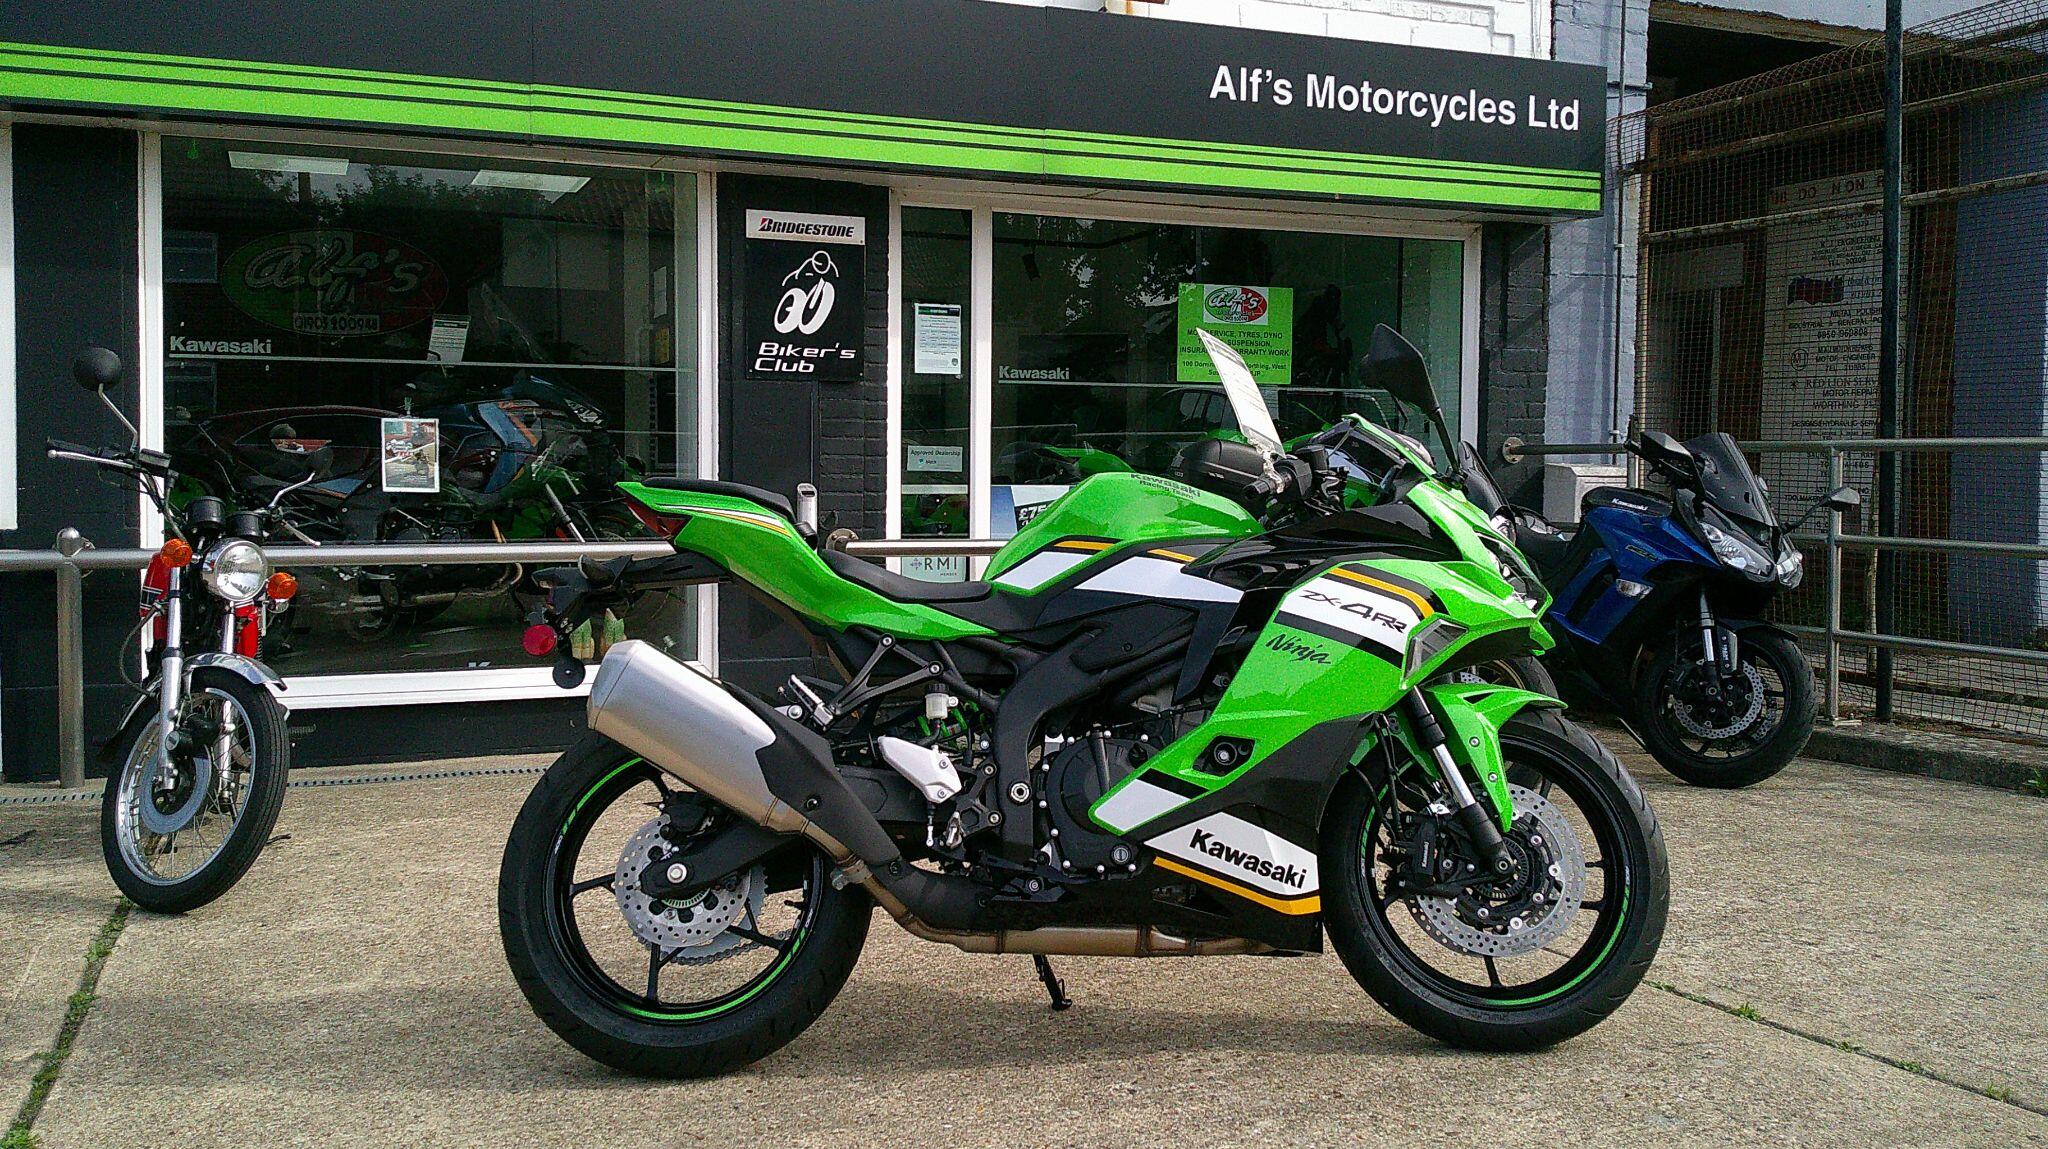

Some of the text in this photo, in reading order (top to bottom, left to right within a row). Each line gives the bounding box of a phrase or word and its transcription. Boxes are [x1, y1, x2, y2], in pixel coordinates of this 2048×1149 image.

[1209, 64, 1580, 131] Alf's Motorcycles Ltd
[759, 217, 854, 238] BRIDGESTONE
[169, 335, 272, 354] Kawasaki
[1263, 331, 1283, 339] DYNO
[758, 342, 857, 359] Biker's
[755, 358, 815, 373] Club
[999, 365, 1070, 379] Kawasaki
[1130, 473, 1201, 497] Kawasaki
[1139, 480, 1194, 499] Racing Team
[924, 557, 957, 570] RMI
[1265, 633, 1331, 664] Ninja
[1189, 828, 1307, 889] Kawasaki
